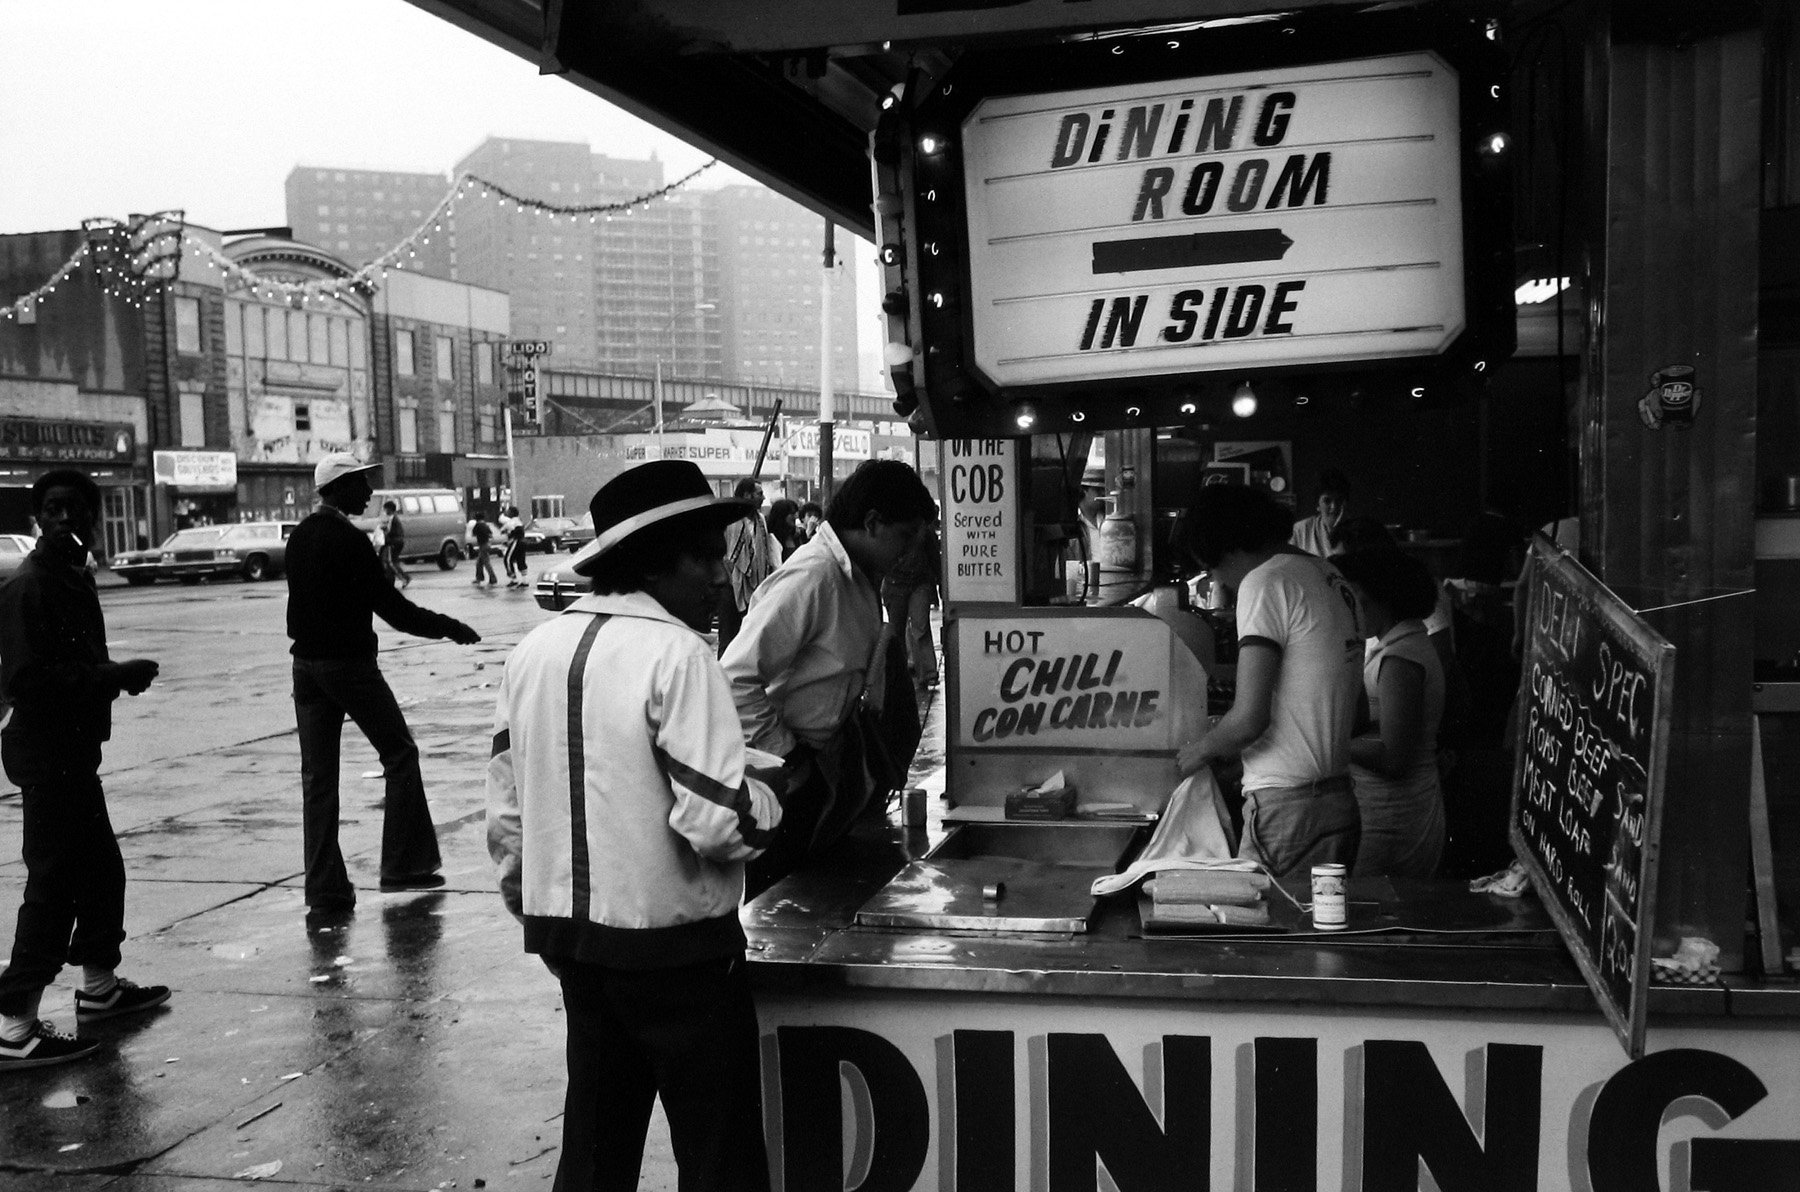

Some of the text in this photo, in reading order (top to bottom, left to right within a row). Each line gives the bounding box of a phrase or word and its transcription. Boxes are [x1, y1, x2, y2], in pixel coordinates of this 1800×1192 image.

[1132, 152, 1332, 221] ROOM
[1080, 280, 1306, 351] IN SIDE
[512, 342, 547, 353] LIDO
[524, 355, 536, 423] HOTEL
[689, 446, 731, 459] SUPER
[979, 440, 1005, 456] THE
[951, 464, 1004, 504] COB
[954, 511, 1002, 528] Served
[967, 531, 996, 540] WITH
[957, 563, 1003, 577] BUTTER
[962, 545, 998, 558] PURE
[984, 630, 1045, 654] HOT
[1540, 581, 1581, 662] DELI
[1000, 650, 1123, 703] CHILI
[972, 690, 1161, 743] CON CARNE
[1527, 706, 1563, 767] ROAST
[1574, 716, 1611, 776] BEEF
[1522, 754, 1592, 856] MEAT LOAF
[1523, 809, 1592, 931] ON HARD ROLL
[760, 1025, 1800, 1192] DINING
